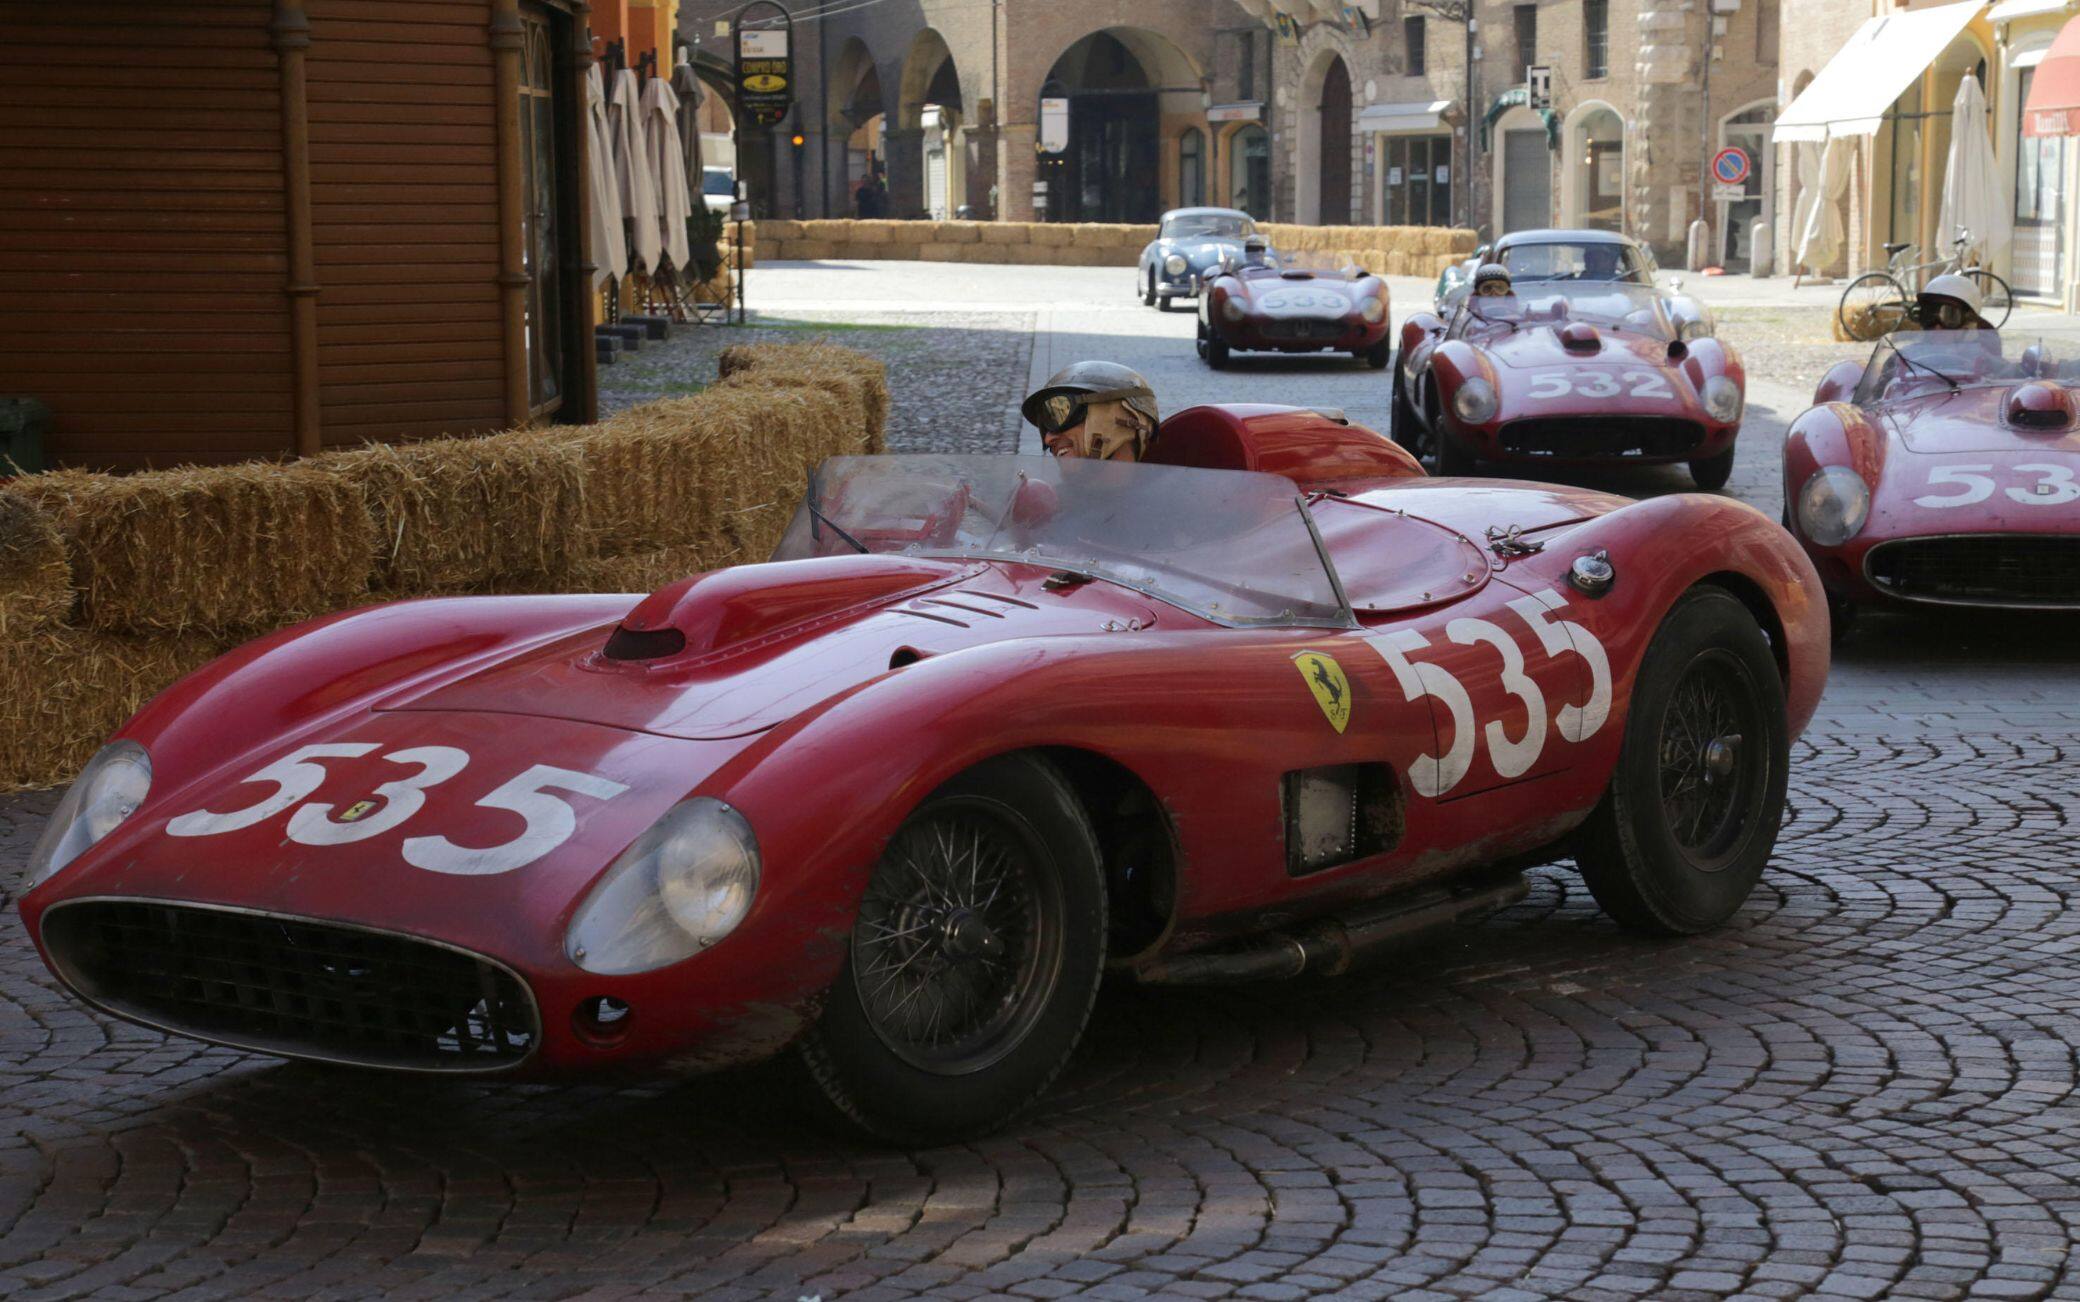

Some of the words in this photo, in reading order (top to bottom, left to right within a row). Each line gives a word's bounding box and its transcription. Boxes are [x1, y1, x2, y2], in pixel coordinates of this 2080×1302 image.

[1528, 371, 1674, 399] 532
[1364, 588, 1612, 797] 535
[165, 743, 630, 875] 535
